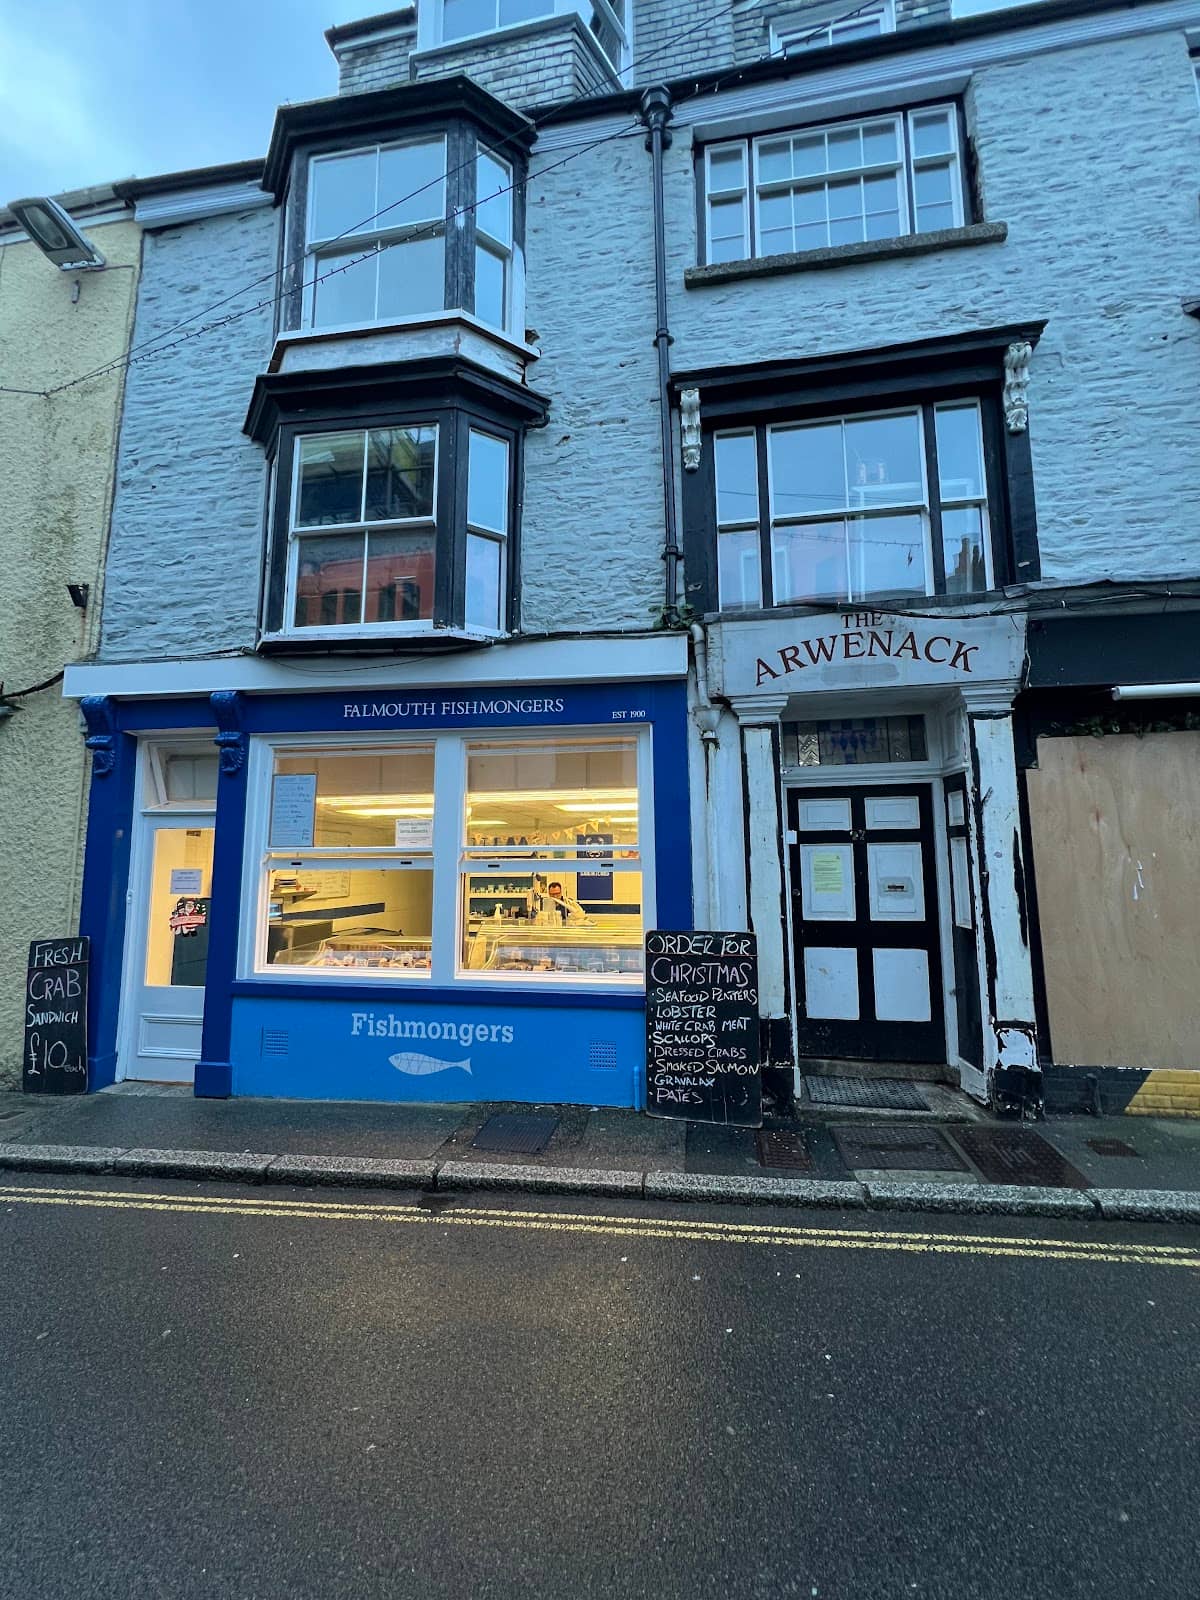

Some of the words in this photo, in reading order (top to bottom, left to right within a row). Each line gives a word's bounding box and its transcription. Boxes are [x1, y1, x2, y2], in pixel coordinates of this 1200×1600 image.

[841, 612, 883, 629] THE
[755, 630, 979, 687] ARWENACK
[343, 702, 435, 718] FALMOUTH
[441, 698, 564, 714] FISHMONGERS
[612, 711, 627, 719] EST
[630, 710, 646, 718] 1900
[34, 942, 83, 968] FRESH
[647, 934, 715, 956] ORDER
[721, 934, 751, 957] FOR
[650, 957, 753, 987] CHRISTMAS
[29, 969, 81, 1001] CRAB
[656, 987, 710, 1003] SEAFOOD
[711, 987, 758, 1006] PLATTERS
[26, 1003, 79, 1027] SANDWICH
[656, 1004, 717, 1019] LOBSTER
[351, 1012, 514, 1047] Fishmongers
[654, 1020, 683, 1031] WHITE
[684, 1020, 716, 1032] CRAB
[721, 1016, 751, 1032] MEAT
[652, 1031, 718, 1049] SCALLOPS
[27, 1032, 68, 1075] £10
[654, 1045, 705, 1058] DRESSED
[707, 1046, 747, 1059] CRABS
[656, 1059, 704, 1073] SMOKED
[705, 1059, 760, 1075] SALMON
[654, 1073, 716, 1087] GRAVALAX
